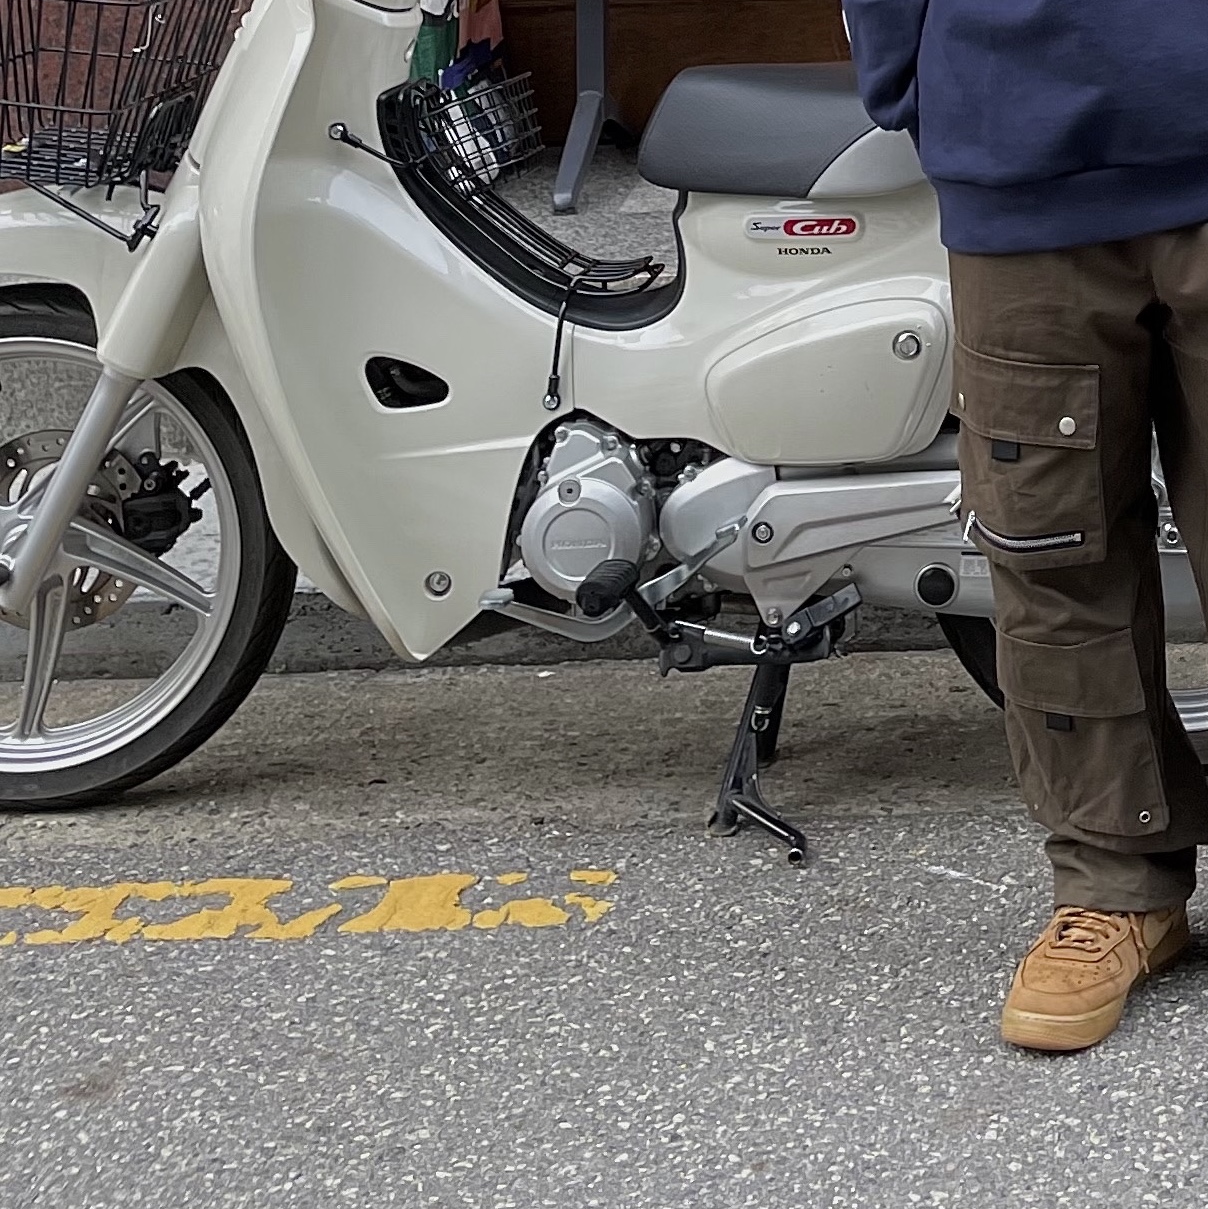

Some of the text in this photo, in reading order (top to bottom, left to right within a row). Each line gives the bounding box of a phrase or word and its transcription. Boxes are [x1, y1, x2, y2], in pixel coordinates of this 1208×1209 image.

[750, 219, 848, 235] Super Cub
[776, 246, 833, 256] HONDA
